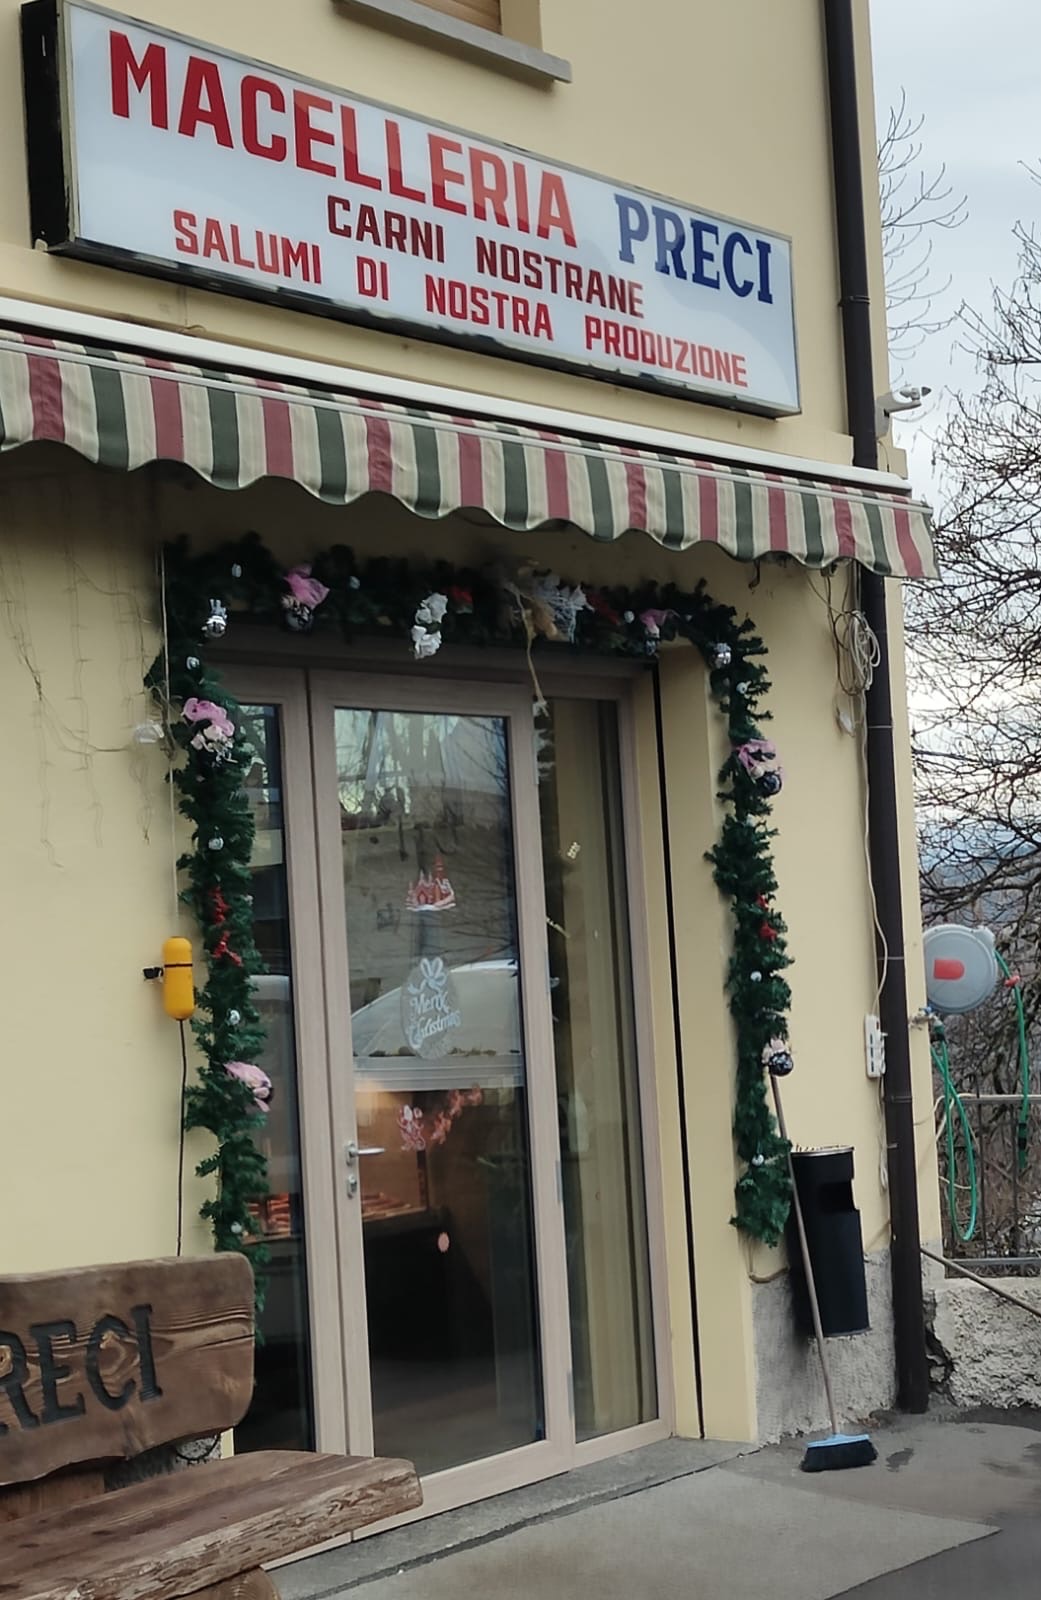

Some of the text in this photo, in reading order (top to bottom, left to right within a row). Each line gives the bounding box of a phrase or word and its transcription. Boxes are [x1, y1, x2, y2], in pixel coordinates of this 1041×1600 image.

[110, 30, 774, 305] MACELLERIA PRECI
[327, 194, 644, 319] CARNI NOSTRANE
[173, 209, 748, 387] SALUMI DI NOSTRA PRODUZIONE
